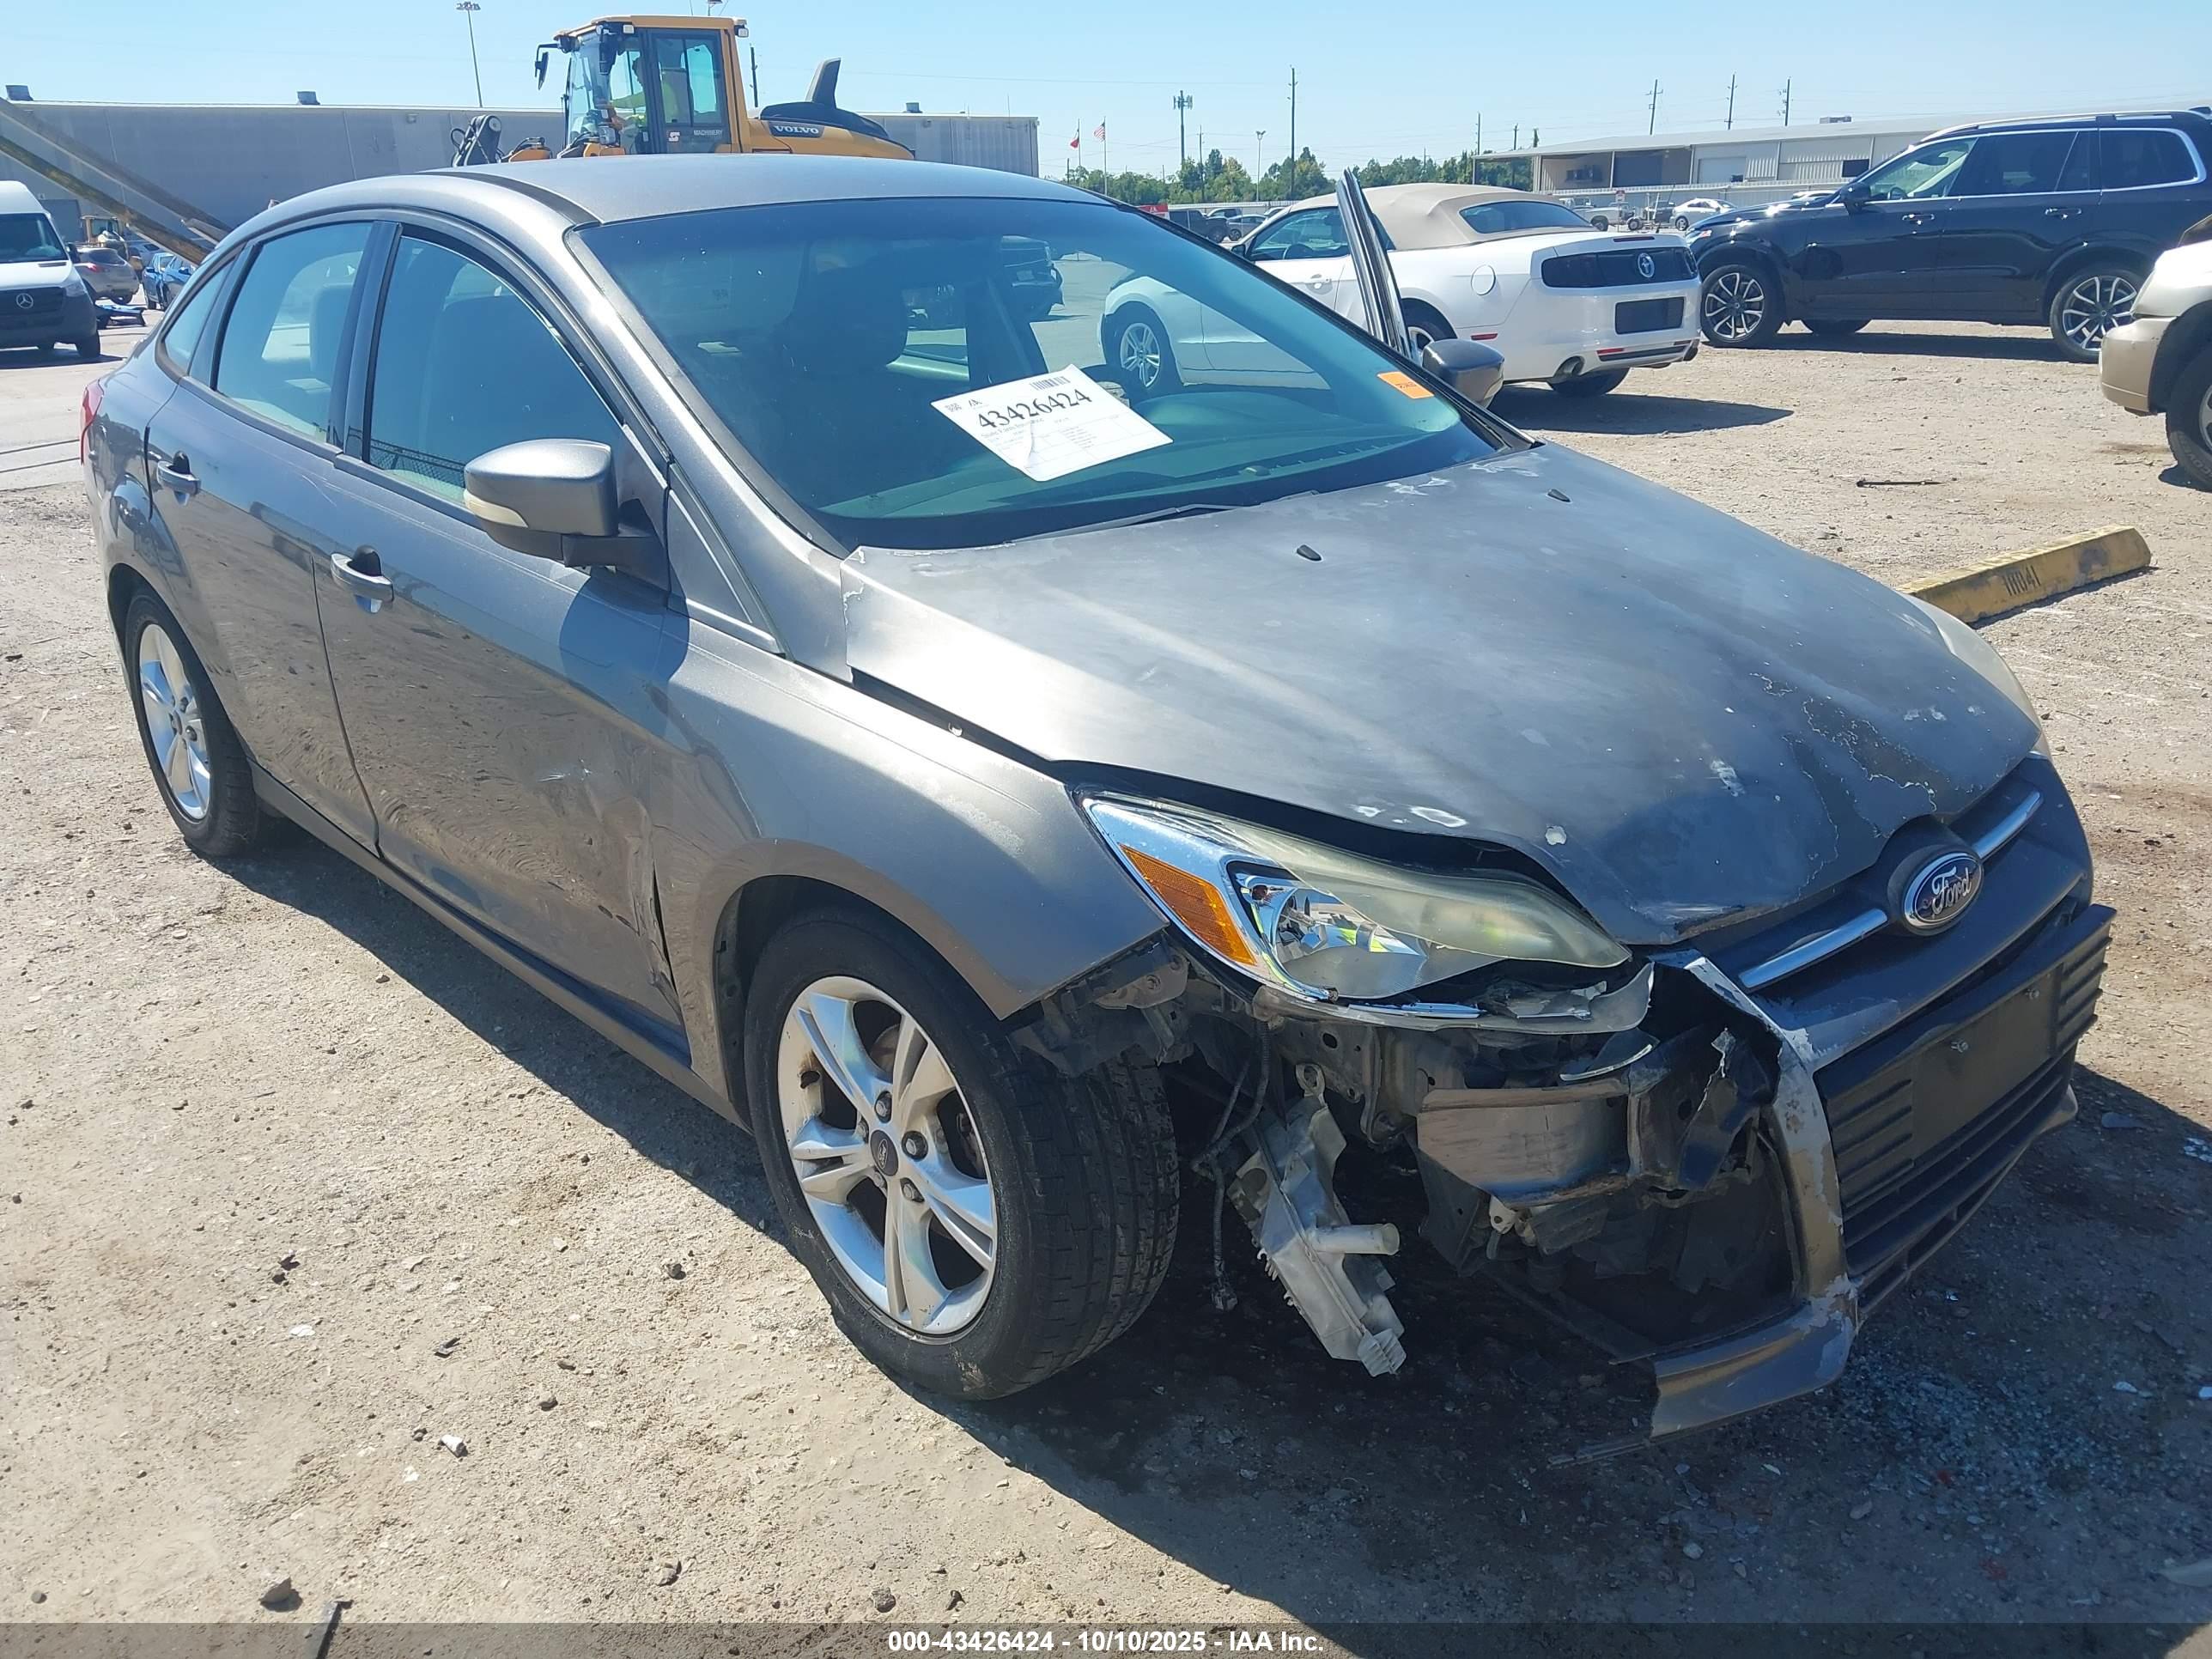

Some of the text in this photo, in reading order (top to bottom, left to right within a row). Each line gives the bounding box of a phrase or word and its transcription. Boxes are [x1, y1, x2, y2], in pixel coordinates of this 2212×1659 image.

[775, 125, 819, 134] VOLVO
[978, 389, 1092, 428] 43426424
[1932, 866, 1972, 915] Ford
